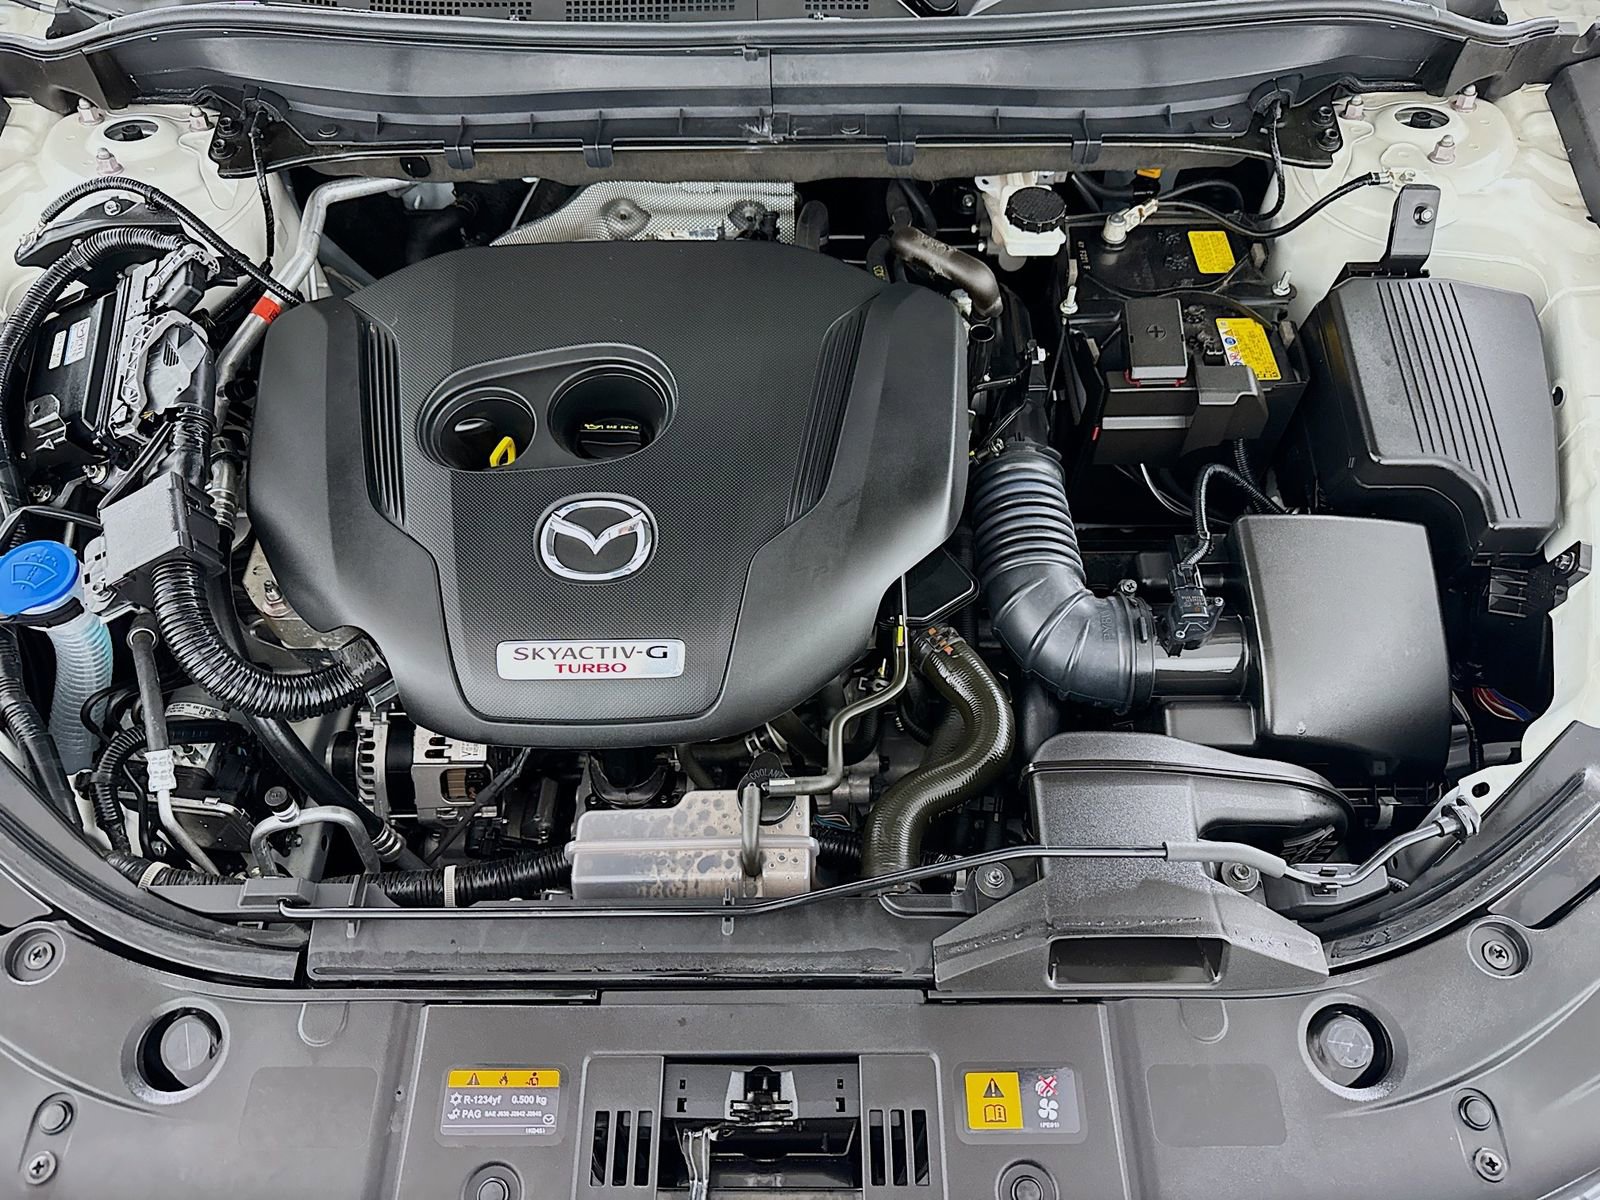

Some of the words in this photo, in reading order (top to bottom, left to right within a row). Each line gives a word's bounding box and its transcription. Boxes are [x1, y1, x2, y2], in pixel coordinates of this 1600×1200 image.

[513, 645, 669, 661] SKYACTIV-G
[554, 662, 627, 674] TURBO
[463, 1095, 502, 1106] R-1234yf
[511, 1095, 534, 1105] 0.500
[536, 1095, 547, 1106] kg
[461, 1109, 482, 1119] PAG
